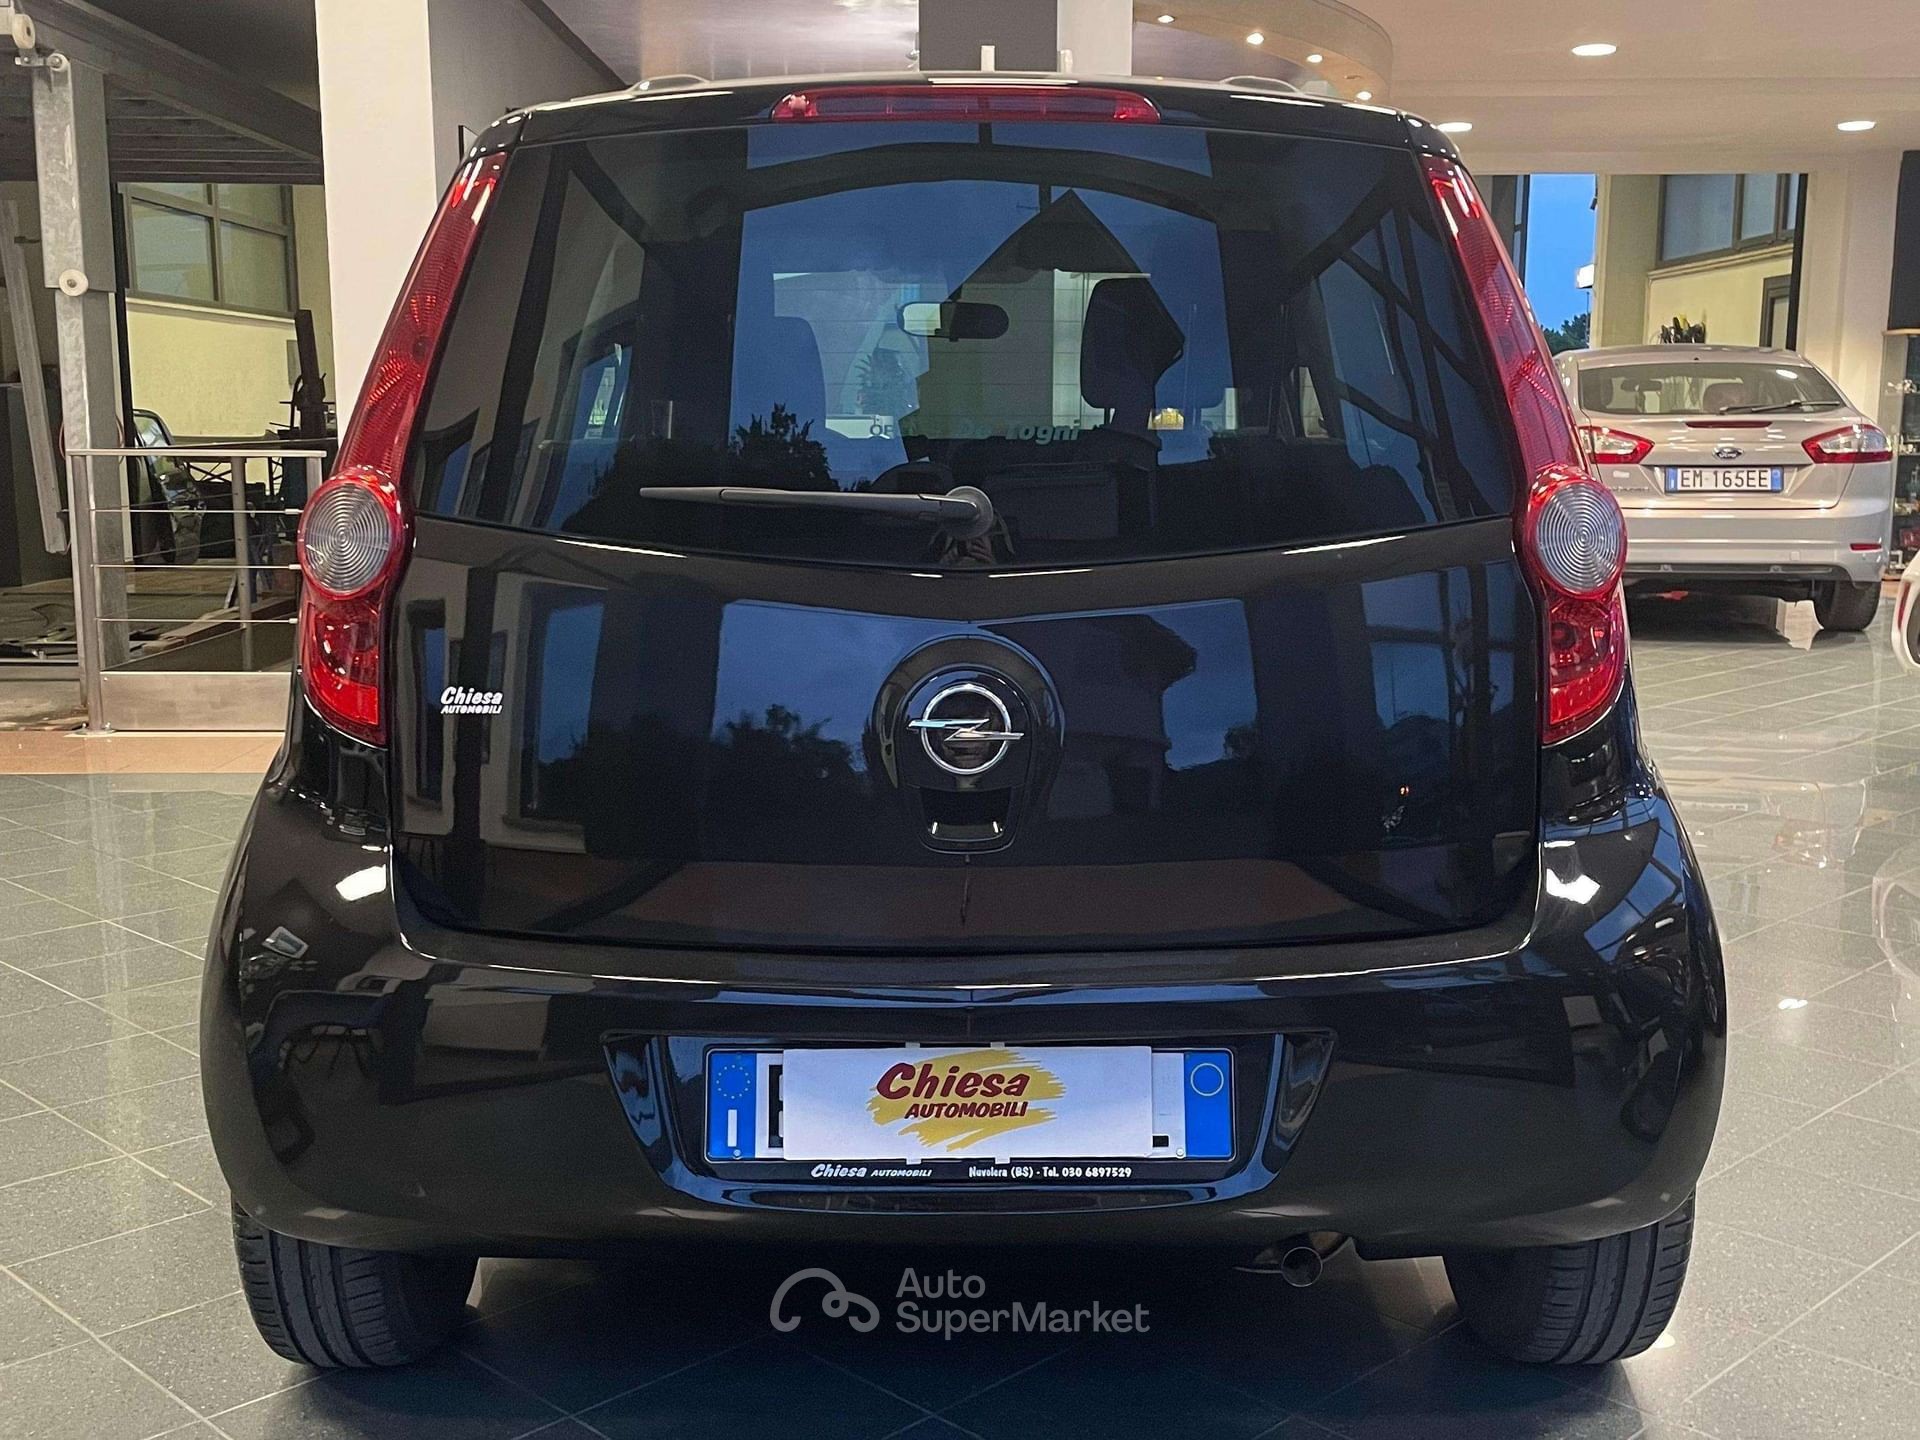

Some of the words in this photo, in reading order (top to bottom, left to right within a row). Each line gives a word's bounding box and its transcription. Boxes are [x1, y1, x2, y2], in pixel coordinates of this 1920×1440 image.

[1680, 469, 1704, 488] EM
[1713, 469, 1769, 488] 165EE
[440, 686, 503, 705] Chiesa
[440, 705, 503, 714] AUTOMOBILI
[876, 1062, 1031, 1099] Chiesa
[904, 1101, 1029, 1119] AUTOMOBILI
[810, 1163, 868, 1178] Chiesa
[870, 1169, 933, 1177] AUTOMOBILI
[1010, 1166, 1034, 1179] (BS)
[1062, 1166, 1083, 1178] 030
[1085, 1166, 1133, 1178] 6897529
